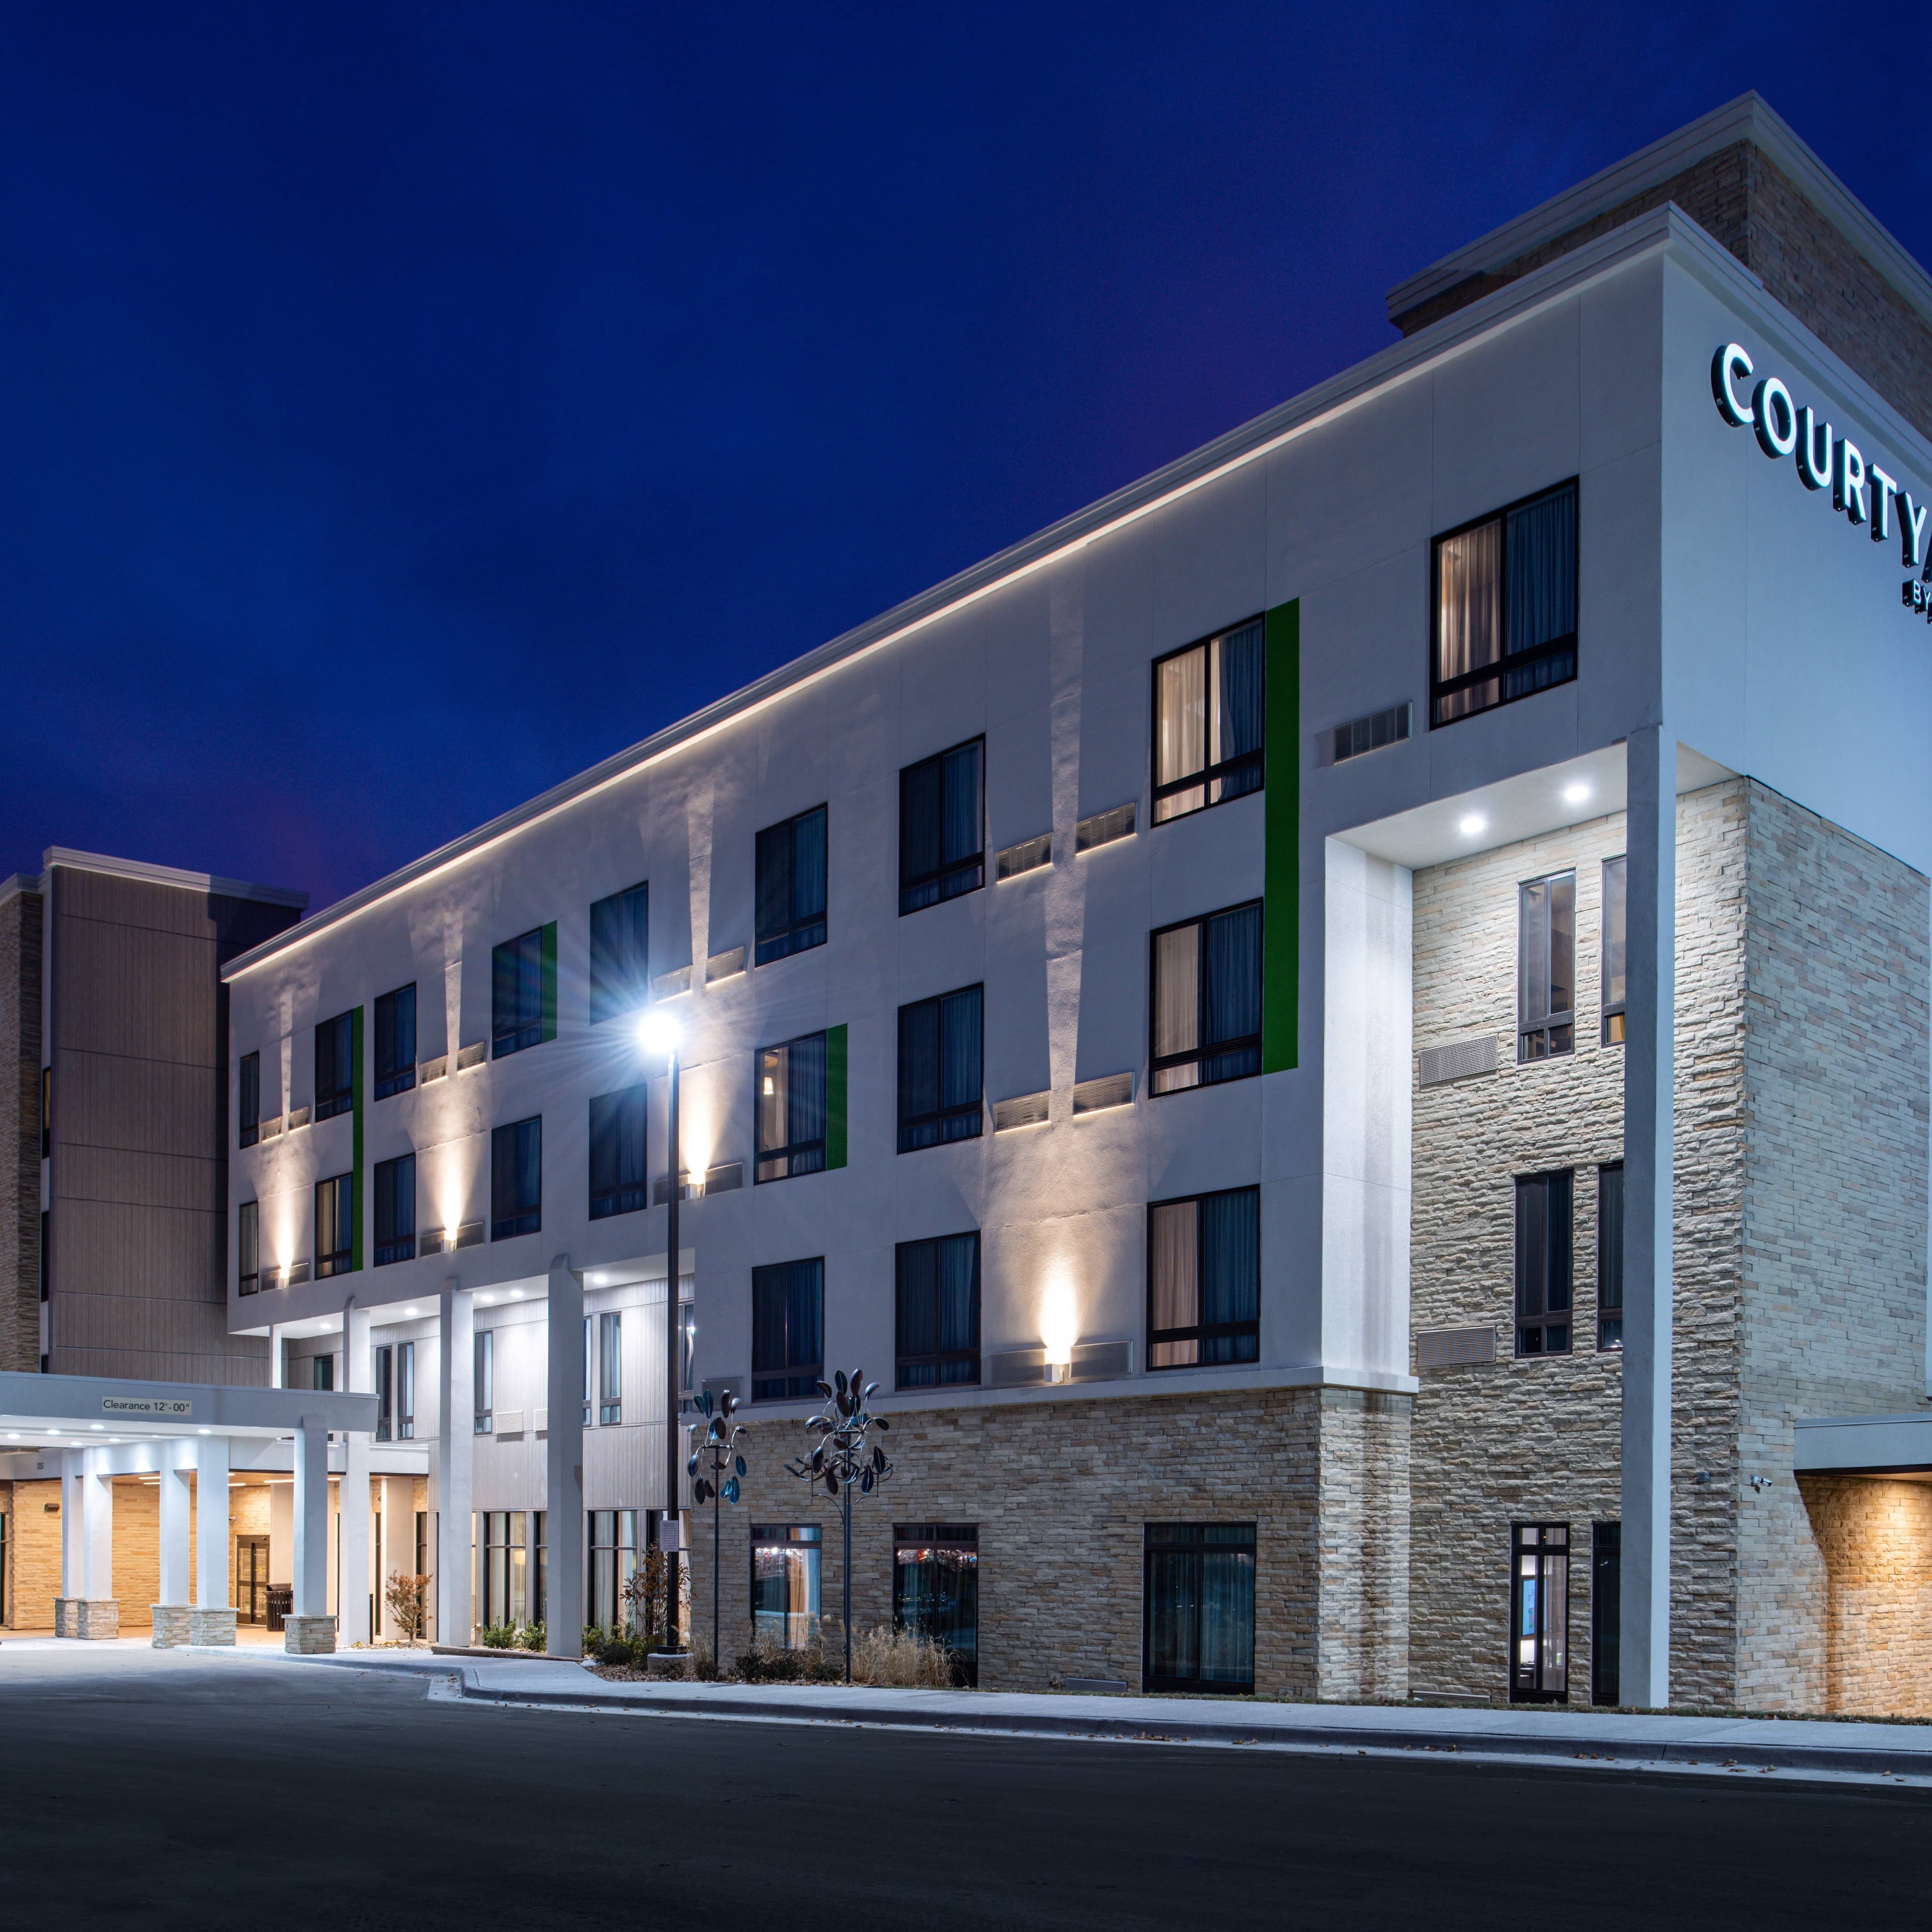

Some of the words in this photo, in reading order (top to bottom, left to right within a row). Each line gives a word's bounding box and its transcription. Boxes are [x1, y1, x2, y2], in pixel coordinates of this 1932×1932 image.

[1711, 343, 1932, 583] COURTY
[1903, 579, 1931, 614] BY
[104, 1400, 150, 1410] Clearance
